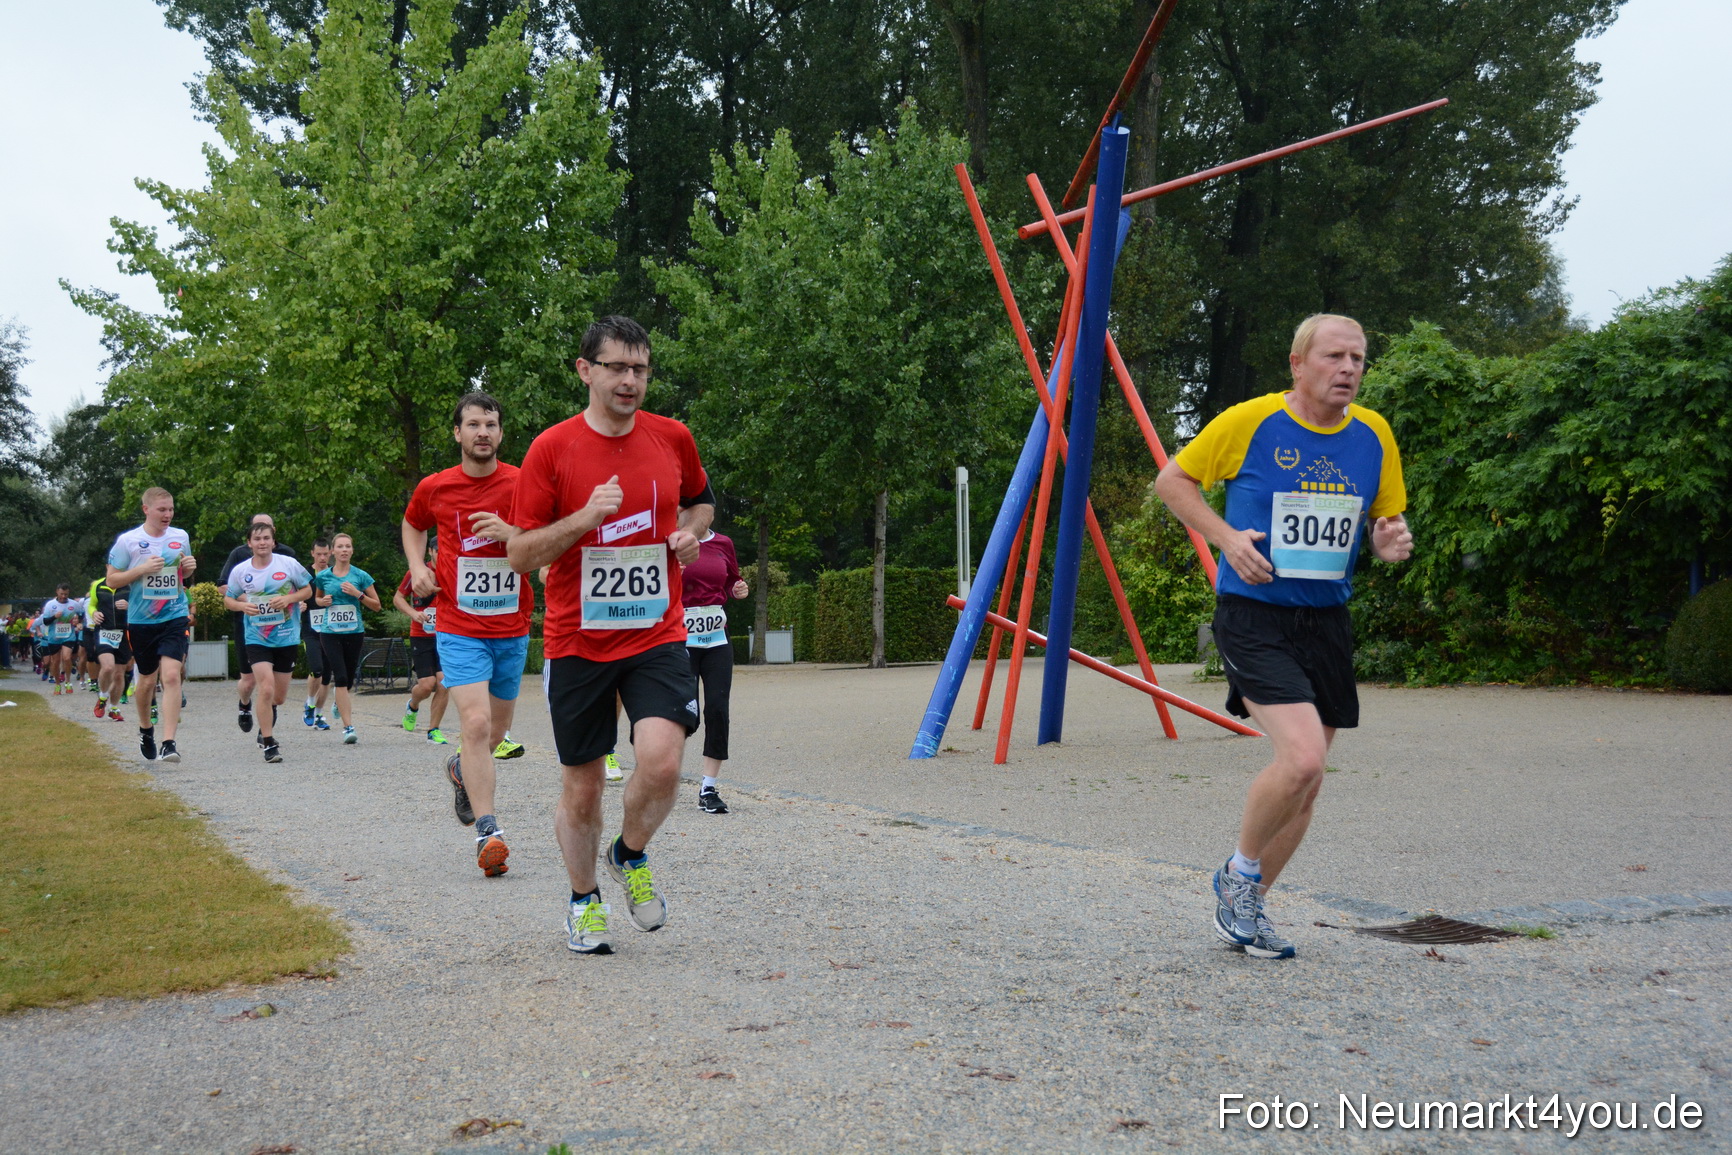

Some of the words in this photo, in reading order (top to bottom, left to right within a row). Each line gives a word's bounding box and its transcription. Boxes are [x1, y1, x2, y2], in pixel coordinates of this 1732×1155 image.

[1314, 497, 1355, 510] BOCK
[616, 519, 639, 534] DEHN
[1282, 514, 1352, 548] 3048
[621, 548, 660, 560] BOCK
[147, 575, 176, 588] 2596
[464, 571, 516, 594] 2314
[591, 565, 661, 598] 2263
[472, 598, 506, 609] Raphael
[330, 611, 355, 622] 2662
[608, 606, 646, 618] Martin
[685, 615, 723, 634] 2302
